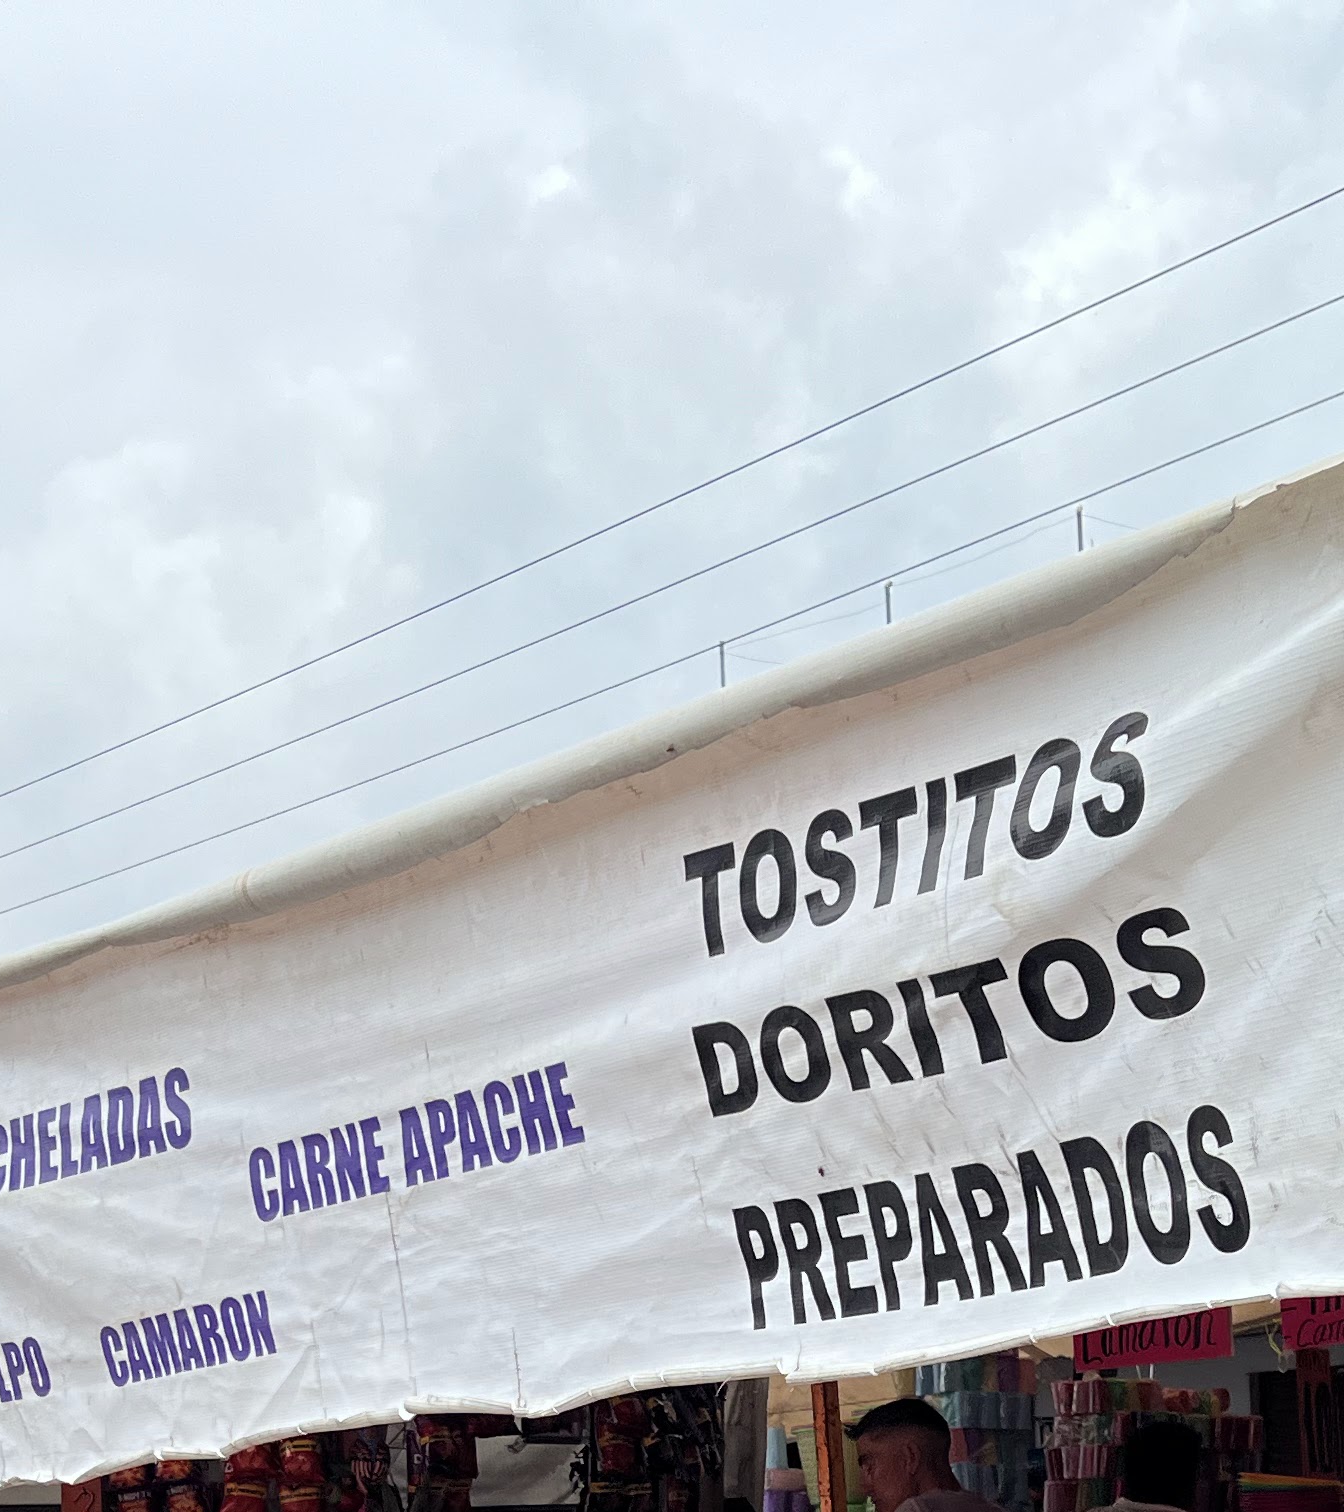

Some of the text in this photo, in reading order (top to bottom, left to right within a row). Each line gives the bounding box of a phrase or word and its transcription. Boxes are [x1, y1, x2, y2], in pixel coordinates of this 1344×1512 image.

[683, 711, 1149, 957] TOSTITOS
[692, 907, 1205, 1116] DORITOS
[248, 1062, 586, 1222] CARNE APACHE
[732, 1105, 1251, 1330] PREPARADOS
[99, 1290, 277, 1387] CAMARON
